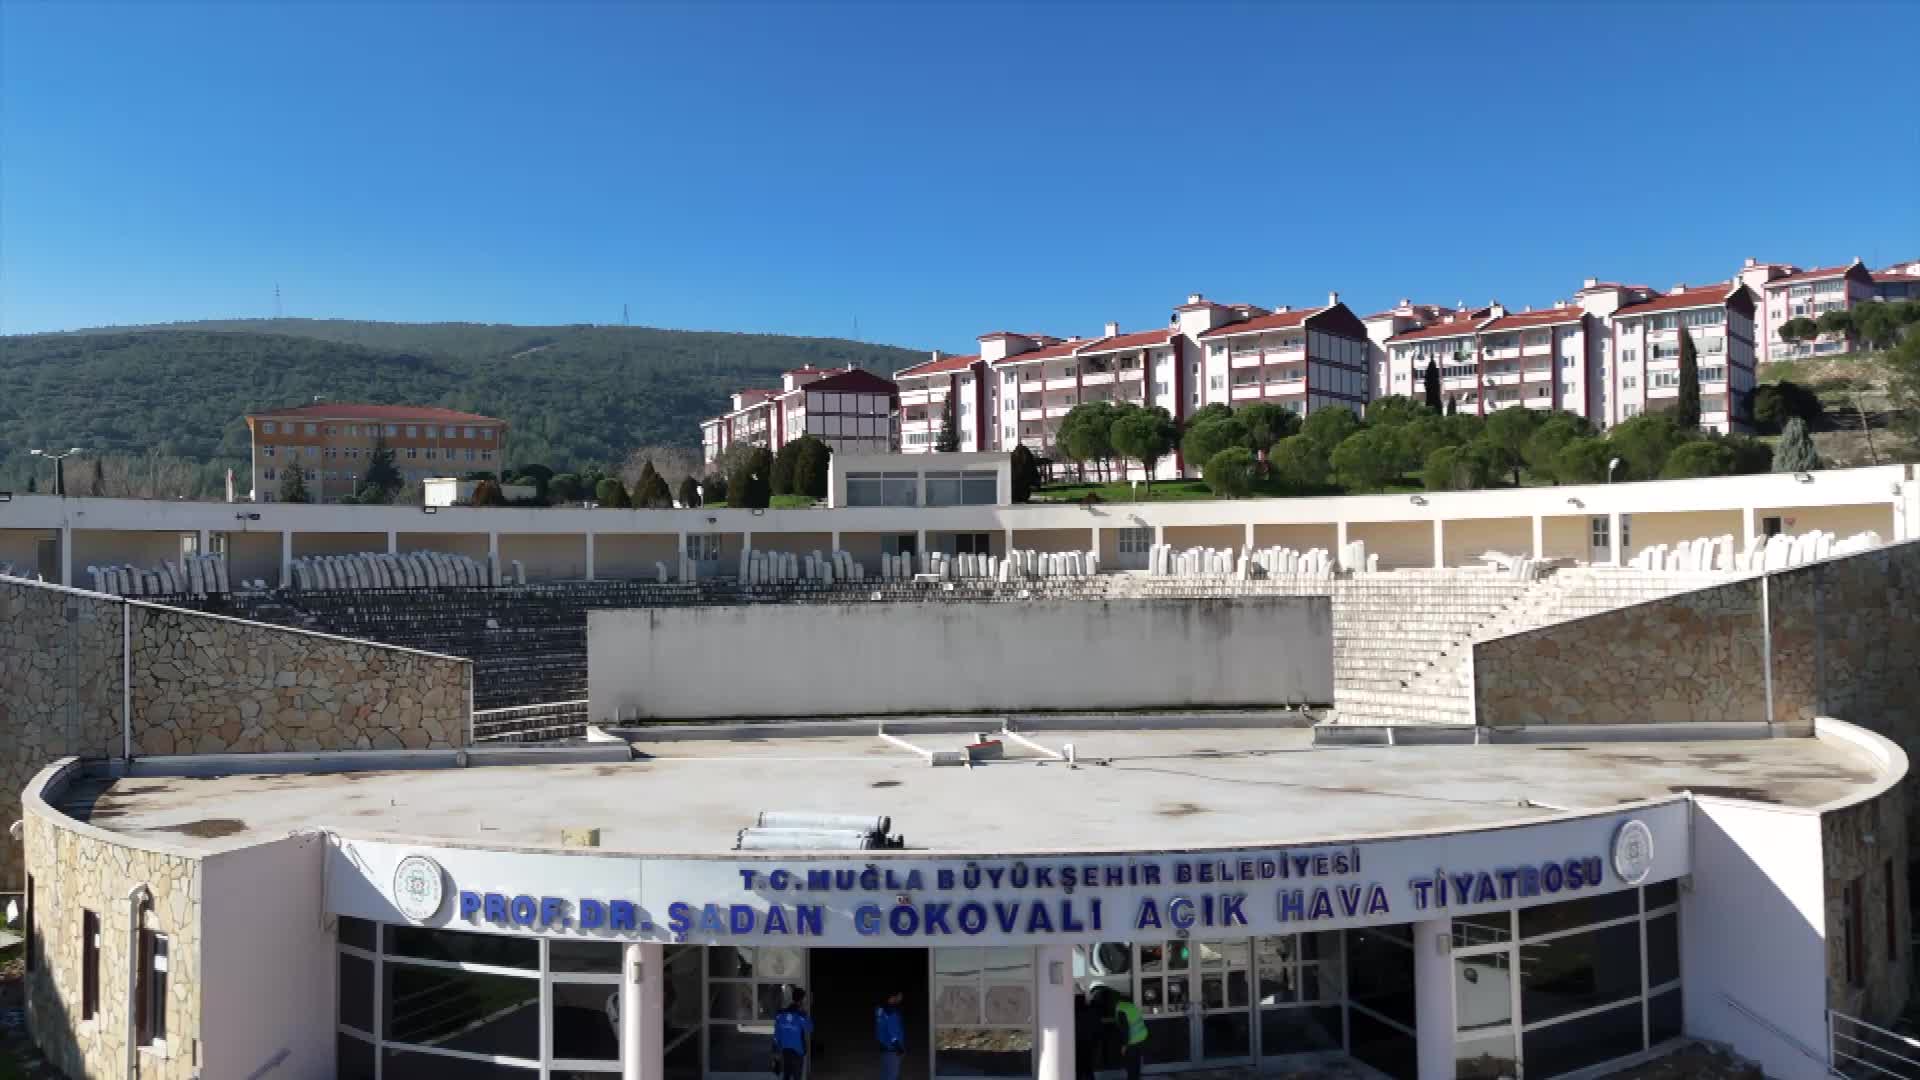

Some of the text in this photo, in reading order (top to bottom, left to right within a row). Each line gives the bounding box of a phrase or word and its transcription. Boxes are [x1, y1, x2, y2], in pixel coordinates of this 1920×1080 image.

[668, 902, 824, 942] ŞADAN
[855, 894, 1102, 936] GÖKOVALI
[1137, 896, 1249, 938] AÇIK
[1280, 886, 1390, 922] HAVA
[1412, 856, 1602, 909] TİYATROSU
[937, 858, 1160, 894] BÜYÜKŞEHİR
[1175, 847, 1360, 884] BELEDİYESİ
